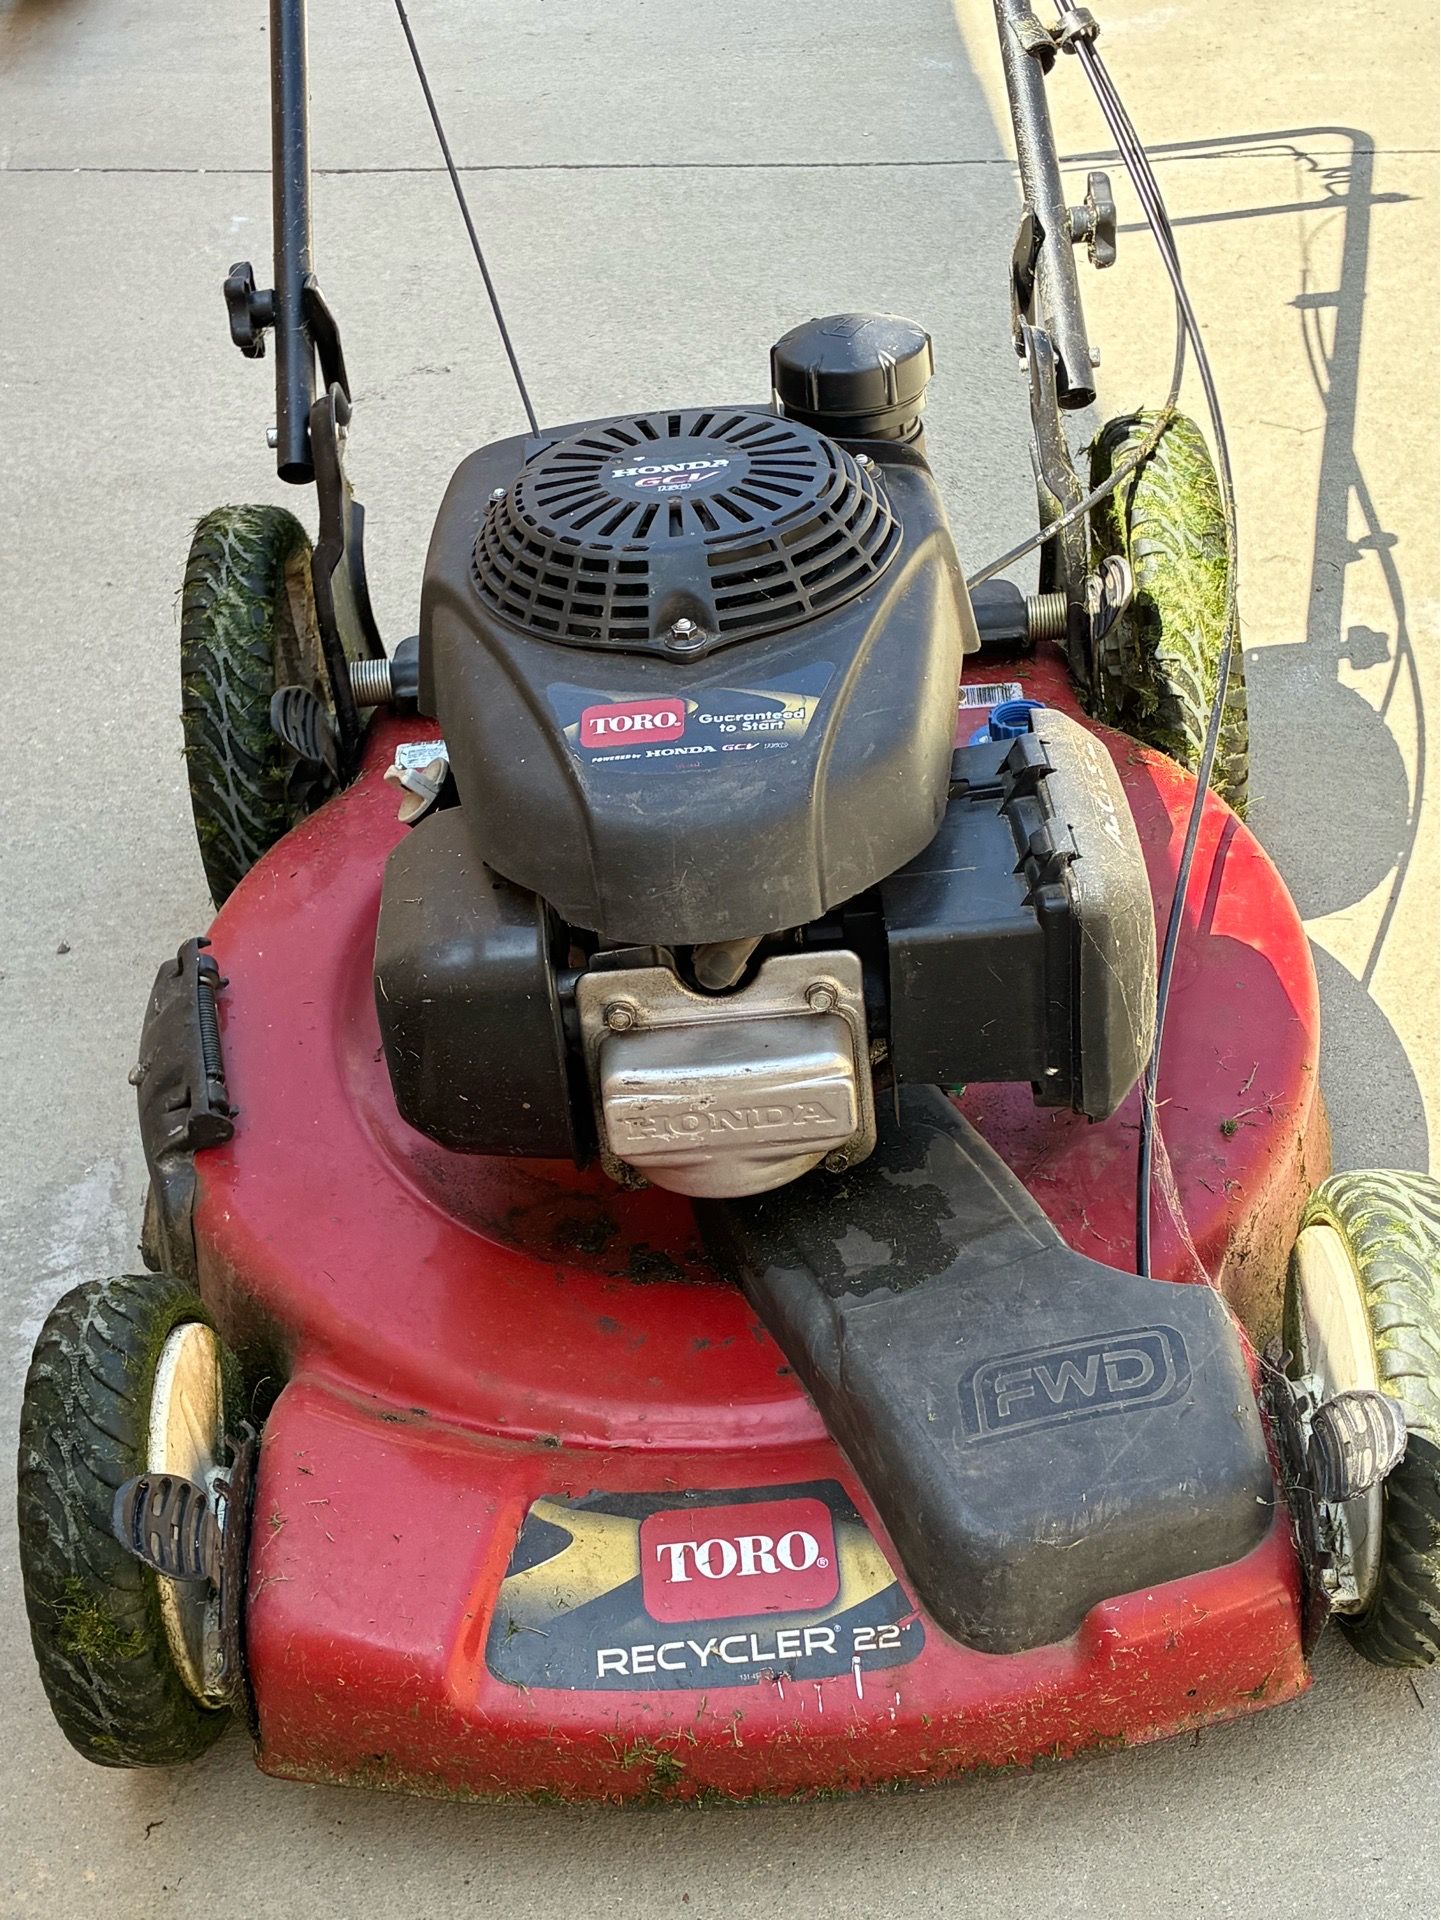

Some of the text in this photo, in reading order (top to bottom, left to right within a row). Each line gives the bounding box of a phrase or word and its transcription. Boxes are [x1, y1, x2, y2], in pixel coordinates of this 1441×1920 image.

[611, 458, 730, 478] HONDA
[634, 470, 721, 488] GCV
[589, 711, 677, 735] TORO
[698, 708, 805, 725] Guaranteed
[719, 719, 785, 733] to Start
[645, 744, 717, 758] HONDA
[722, 742, 760, 752] GCV
[617, 1100, 837, 1141] HONDA
[994, 1349, 1155, 1418] FWD
[656, 1530, 821, 1584] TORO
[596, 1625, 839, 1678] RECYCLER
